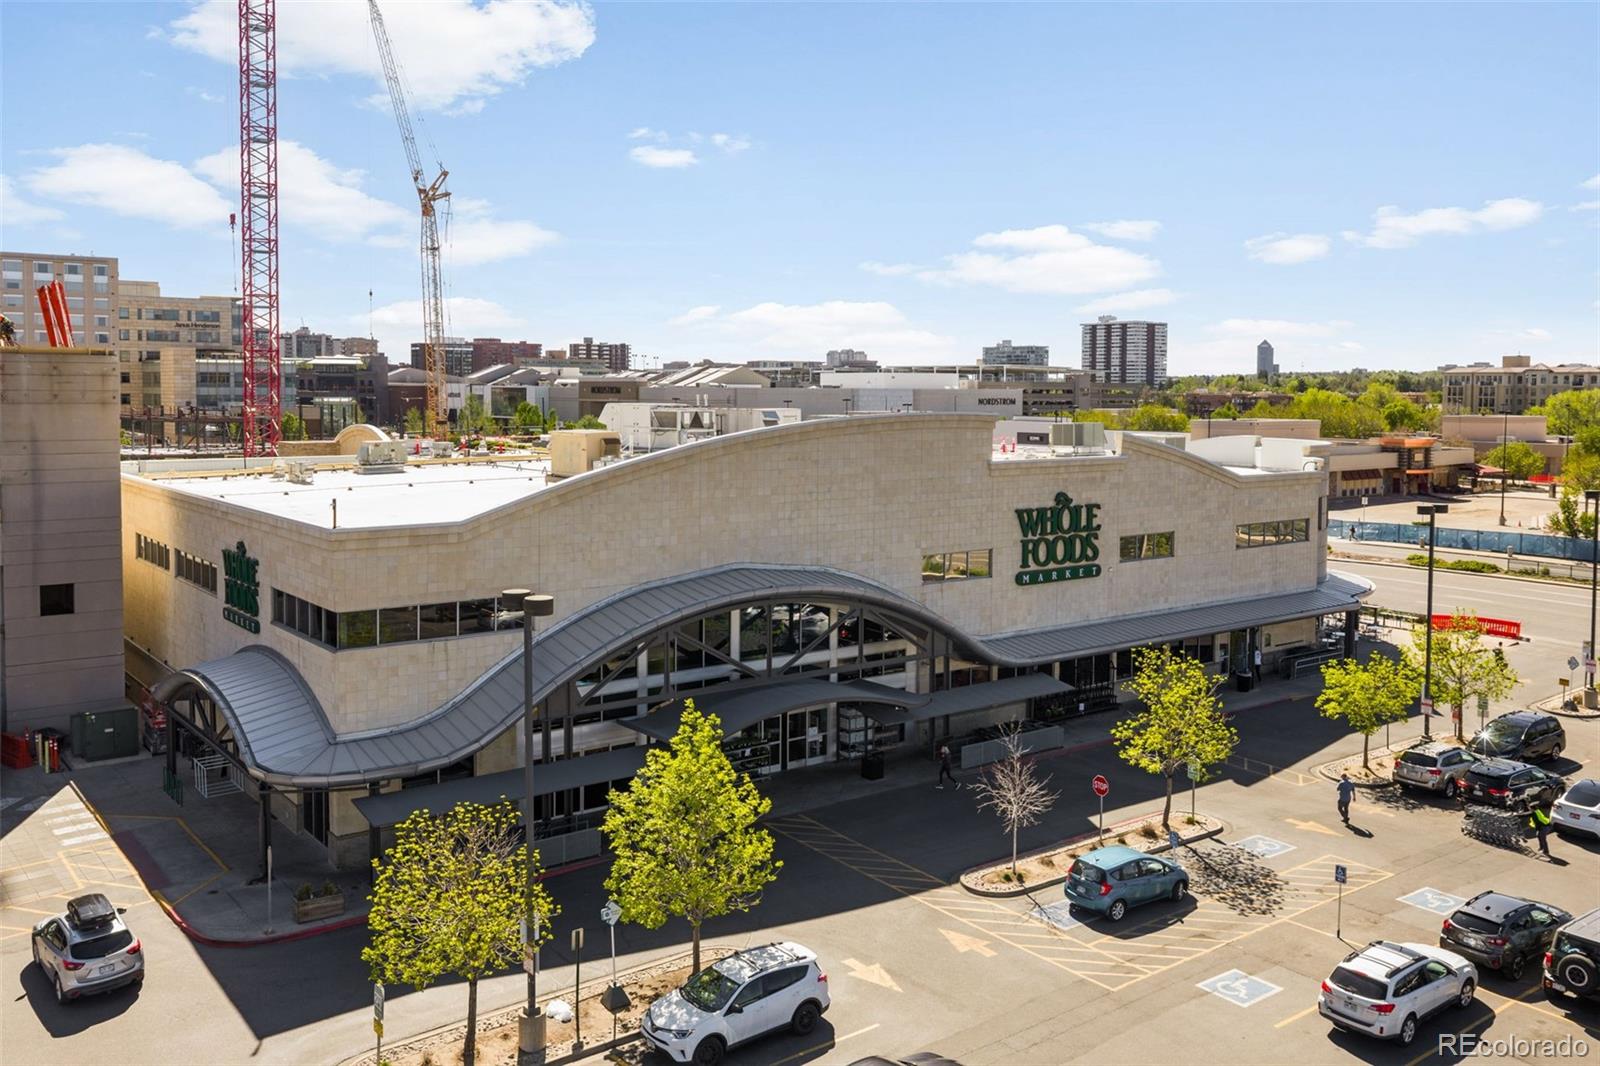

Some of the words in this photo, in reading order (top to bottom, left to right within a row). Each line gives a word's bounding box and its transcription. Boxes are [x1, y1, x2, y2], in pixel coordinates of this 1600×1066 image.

[978, 397, 1016, 406] NORDSTROM
[1014, 503, 1102, 538] WHOLE
[1019, 532, 1100, 569] FOODS
[222, 549, 260, 588] WHOLE
[1022, 567, 1098, 584] MARKET
[1094, 780, 1108, 791] STOP
